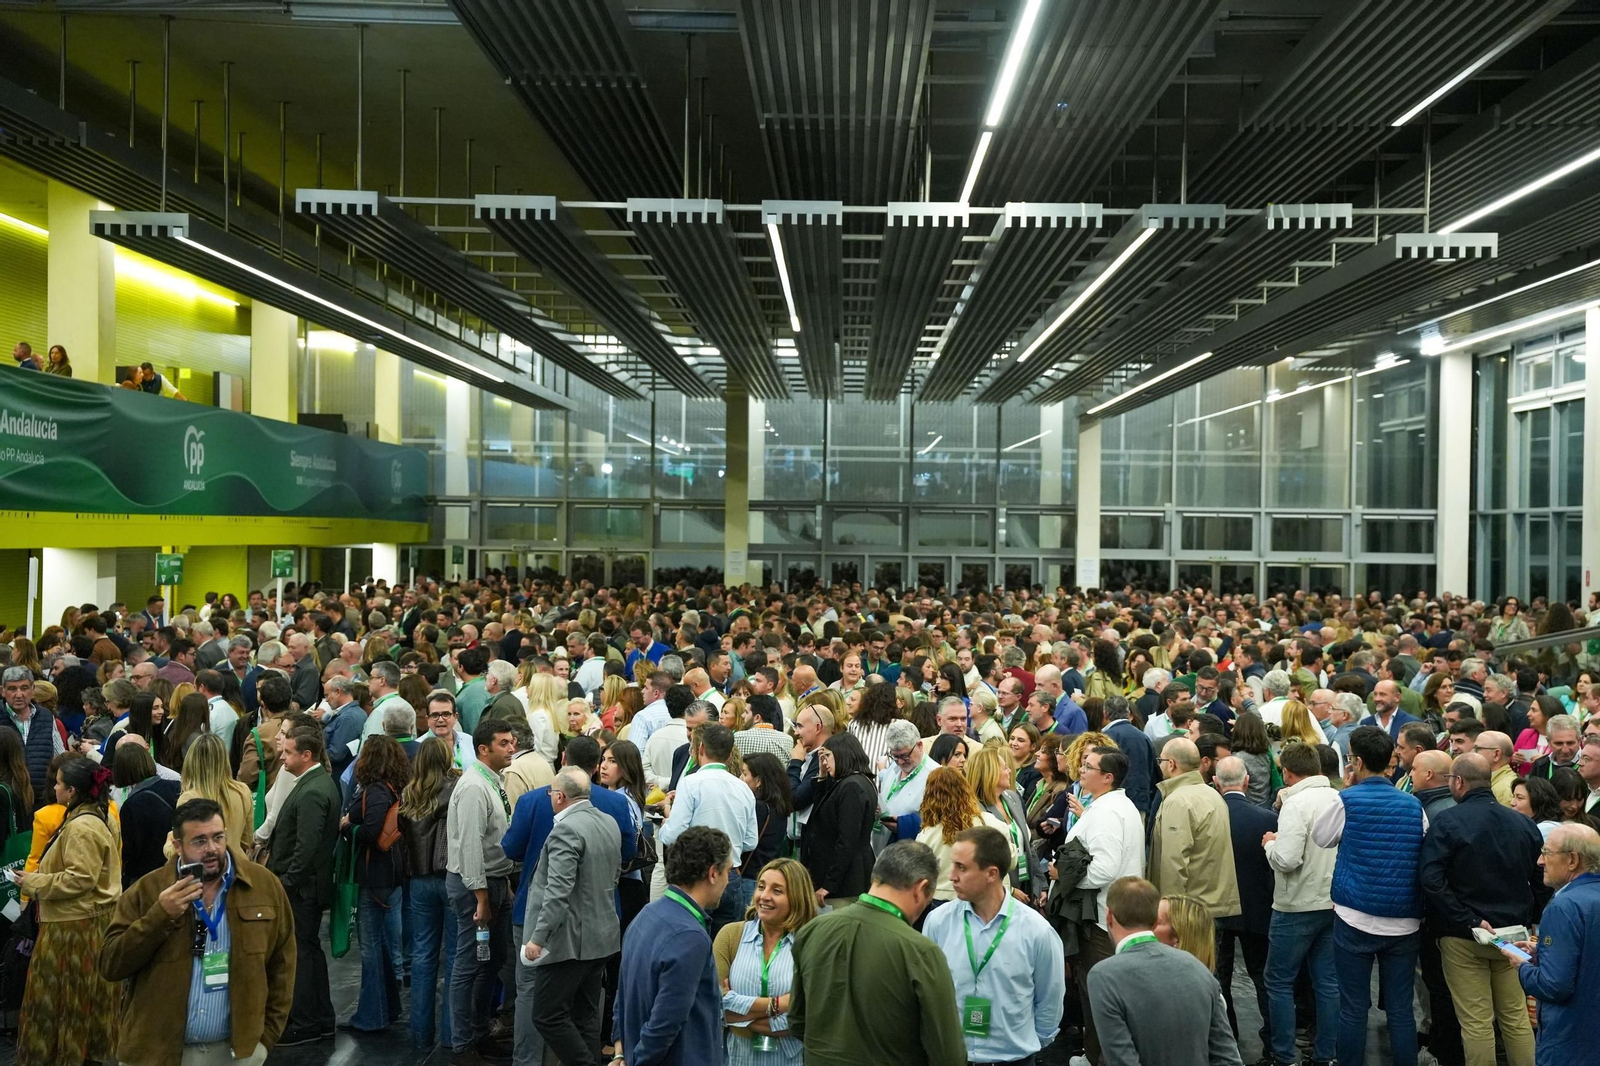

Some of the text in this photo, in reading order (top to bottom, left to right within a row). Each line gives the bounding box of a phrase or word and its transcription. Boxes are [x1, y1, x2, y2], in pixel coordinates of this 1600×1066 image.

[0, 408, 58, 441] Andalucía
[6, 447, 16, 462] PP
[16, 449, 45, 465] Andalucía
